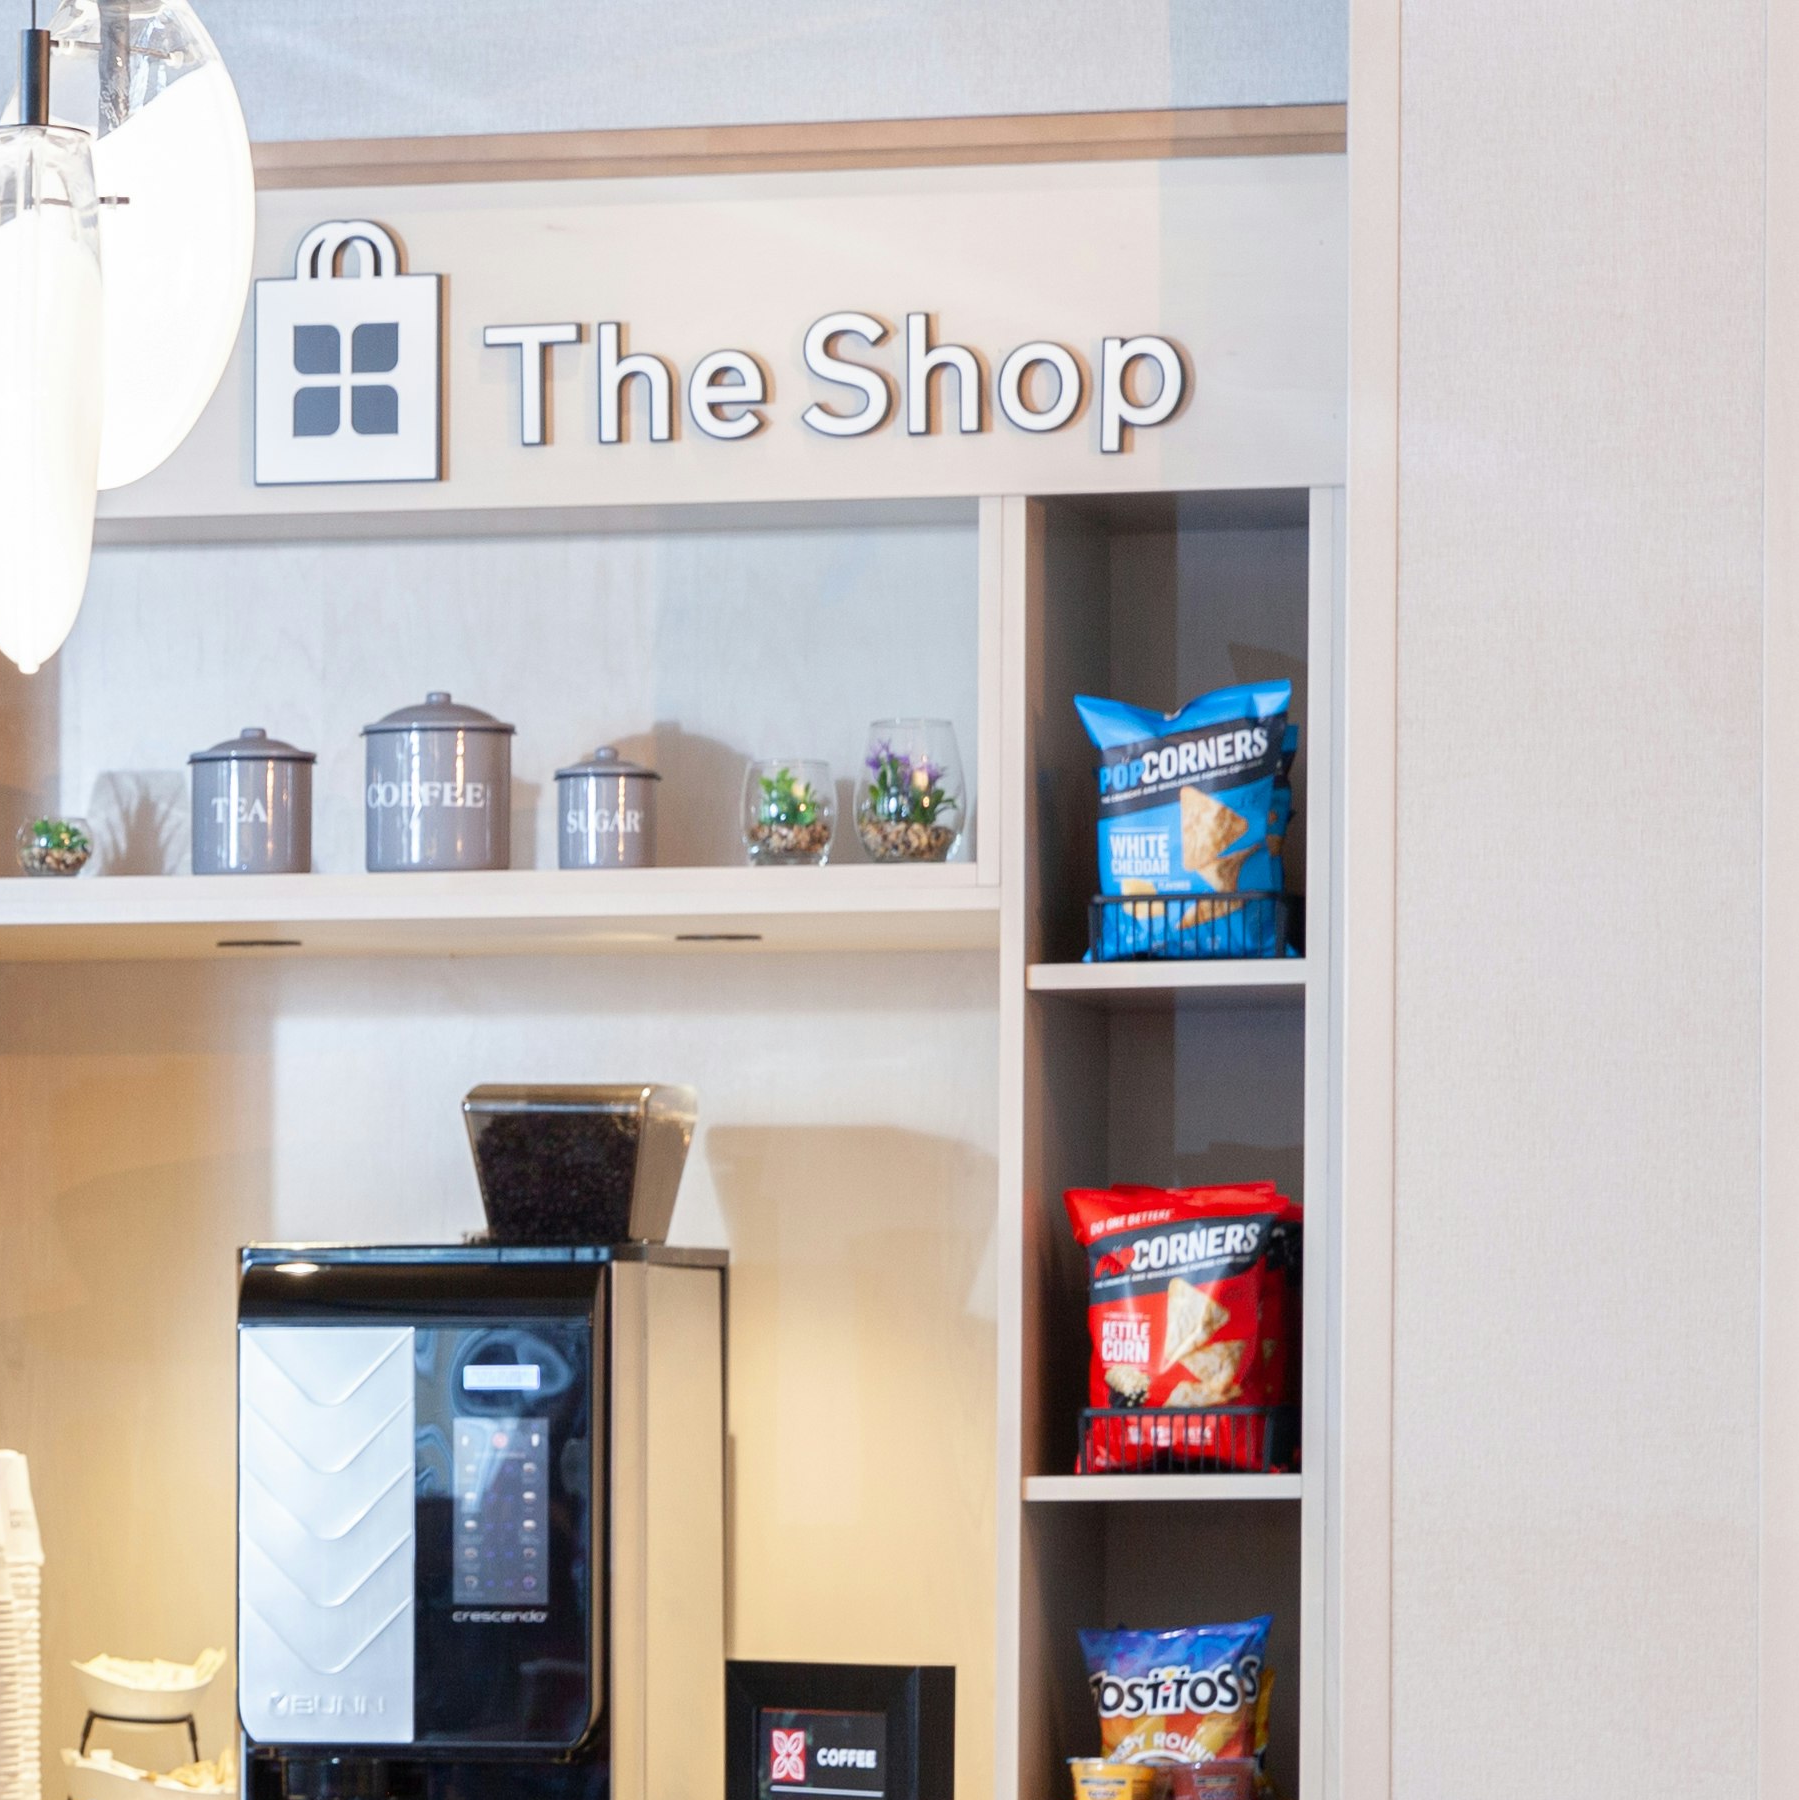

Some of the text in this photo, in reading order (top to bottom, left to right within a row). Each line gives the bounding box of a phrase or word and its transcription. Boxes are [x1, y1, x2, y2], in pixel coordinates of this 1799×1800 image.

[483, 310, 1186, 454] The Shop
[1100, 727, 1269, 795] POPCORNERS
[366, 781, 488, 812] COFFEE
[211, 797, 269, 826] TEA
[566, 808, 643, 835] SUGAR
[1109, 832, 1170, 858] WHITE
[1110, 859, 1170, 876] CHEDDAR
[1101, 1321, 1150, 1341] KETTLE
[1101, 1338, 1150, 1363] CORN
[452, 1610, 548, 1624] crescendo
[290, 1695, 385, 1717] BUNN
[816, 1747, 878, 1769] COFFEE
